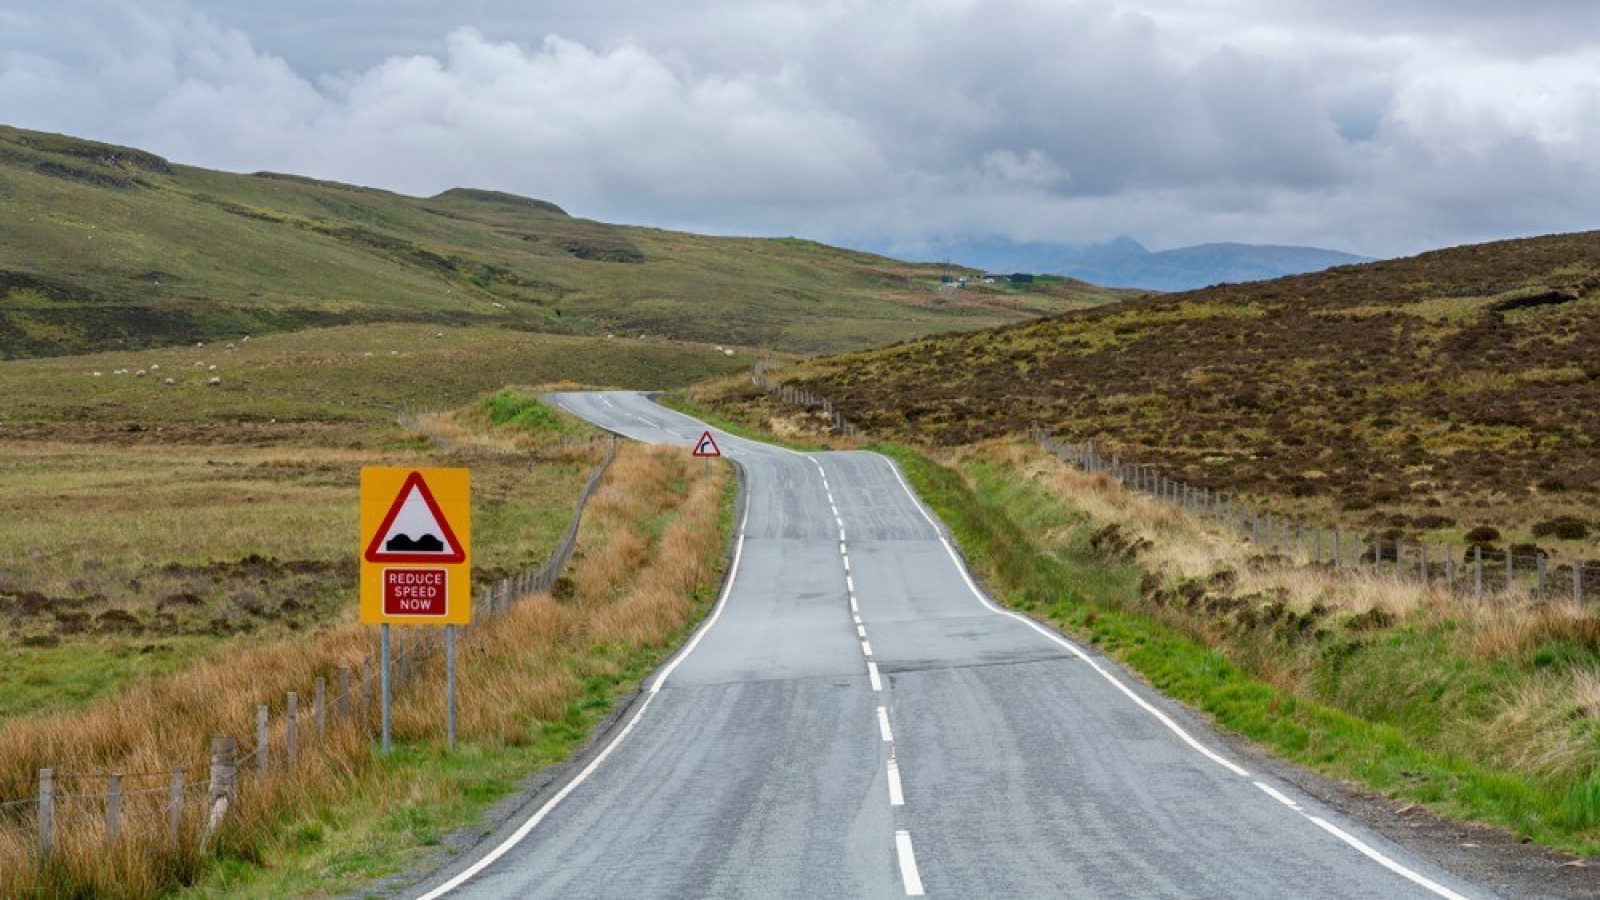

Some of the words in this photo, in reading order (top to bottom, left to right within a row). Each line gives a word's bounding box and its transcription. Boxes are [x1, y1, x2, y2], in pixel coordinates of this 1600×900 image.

[389, 573, 442, 584] REDUCE
[394, 586, 436, 597] SPEED
[400, 599, 431, 610] NOW
